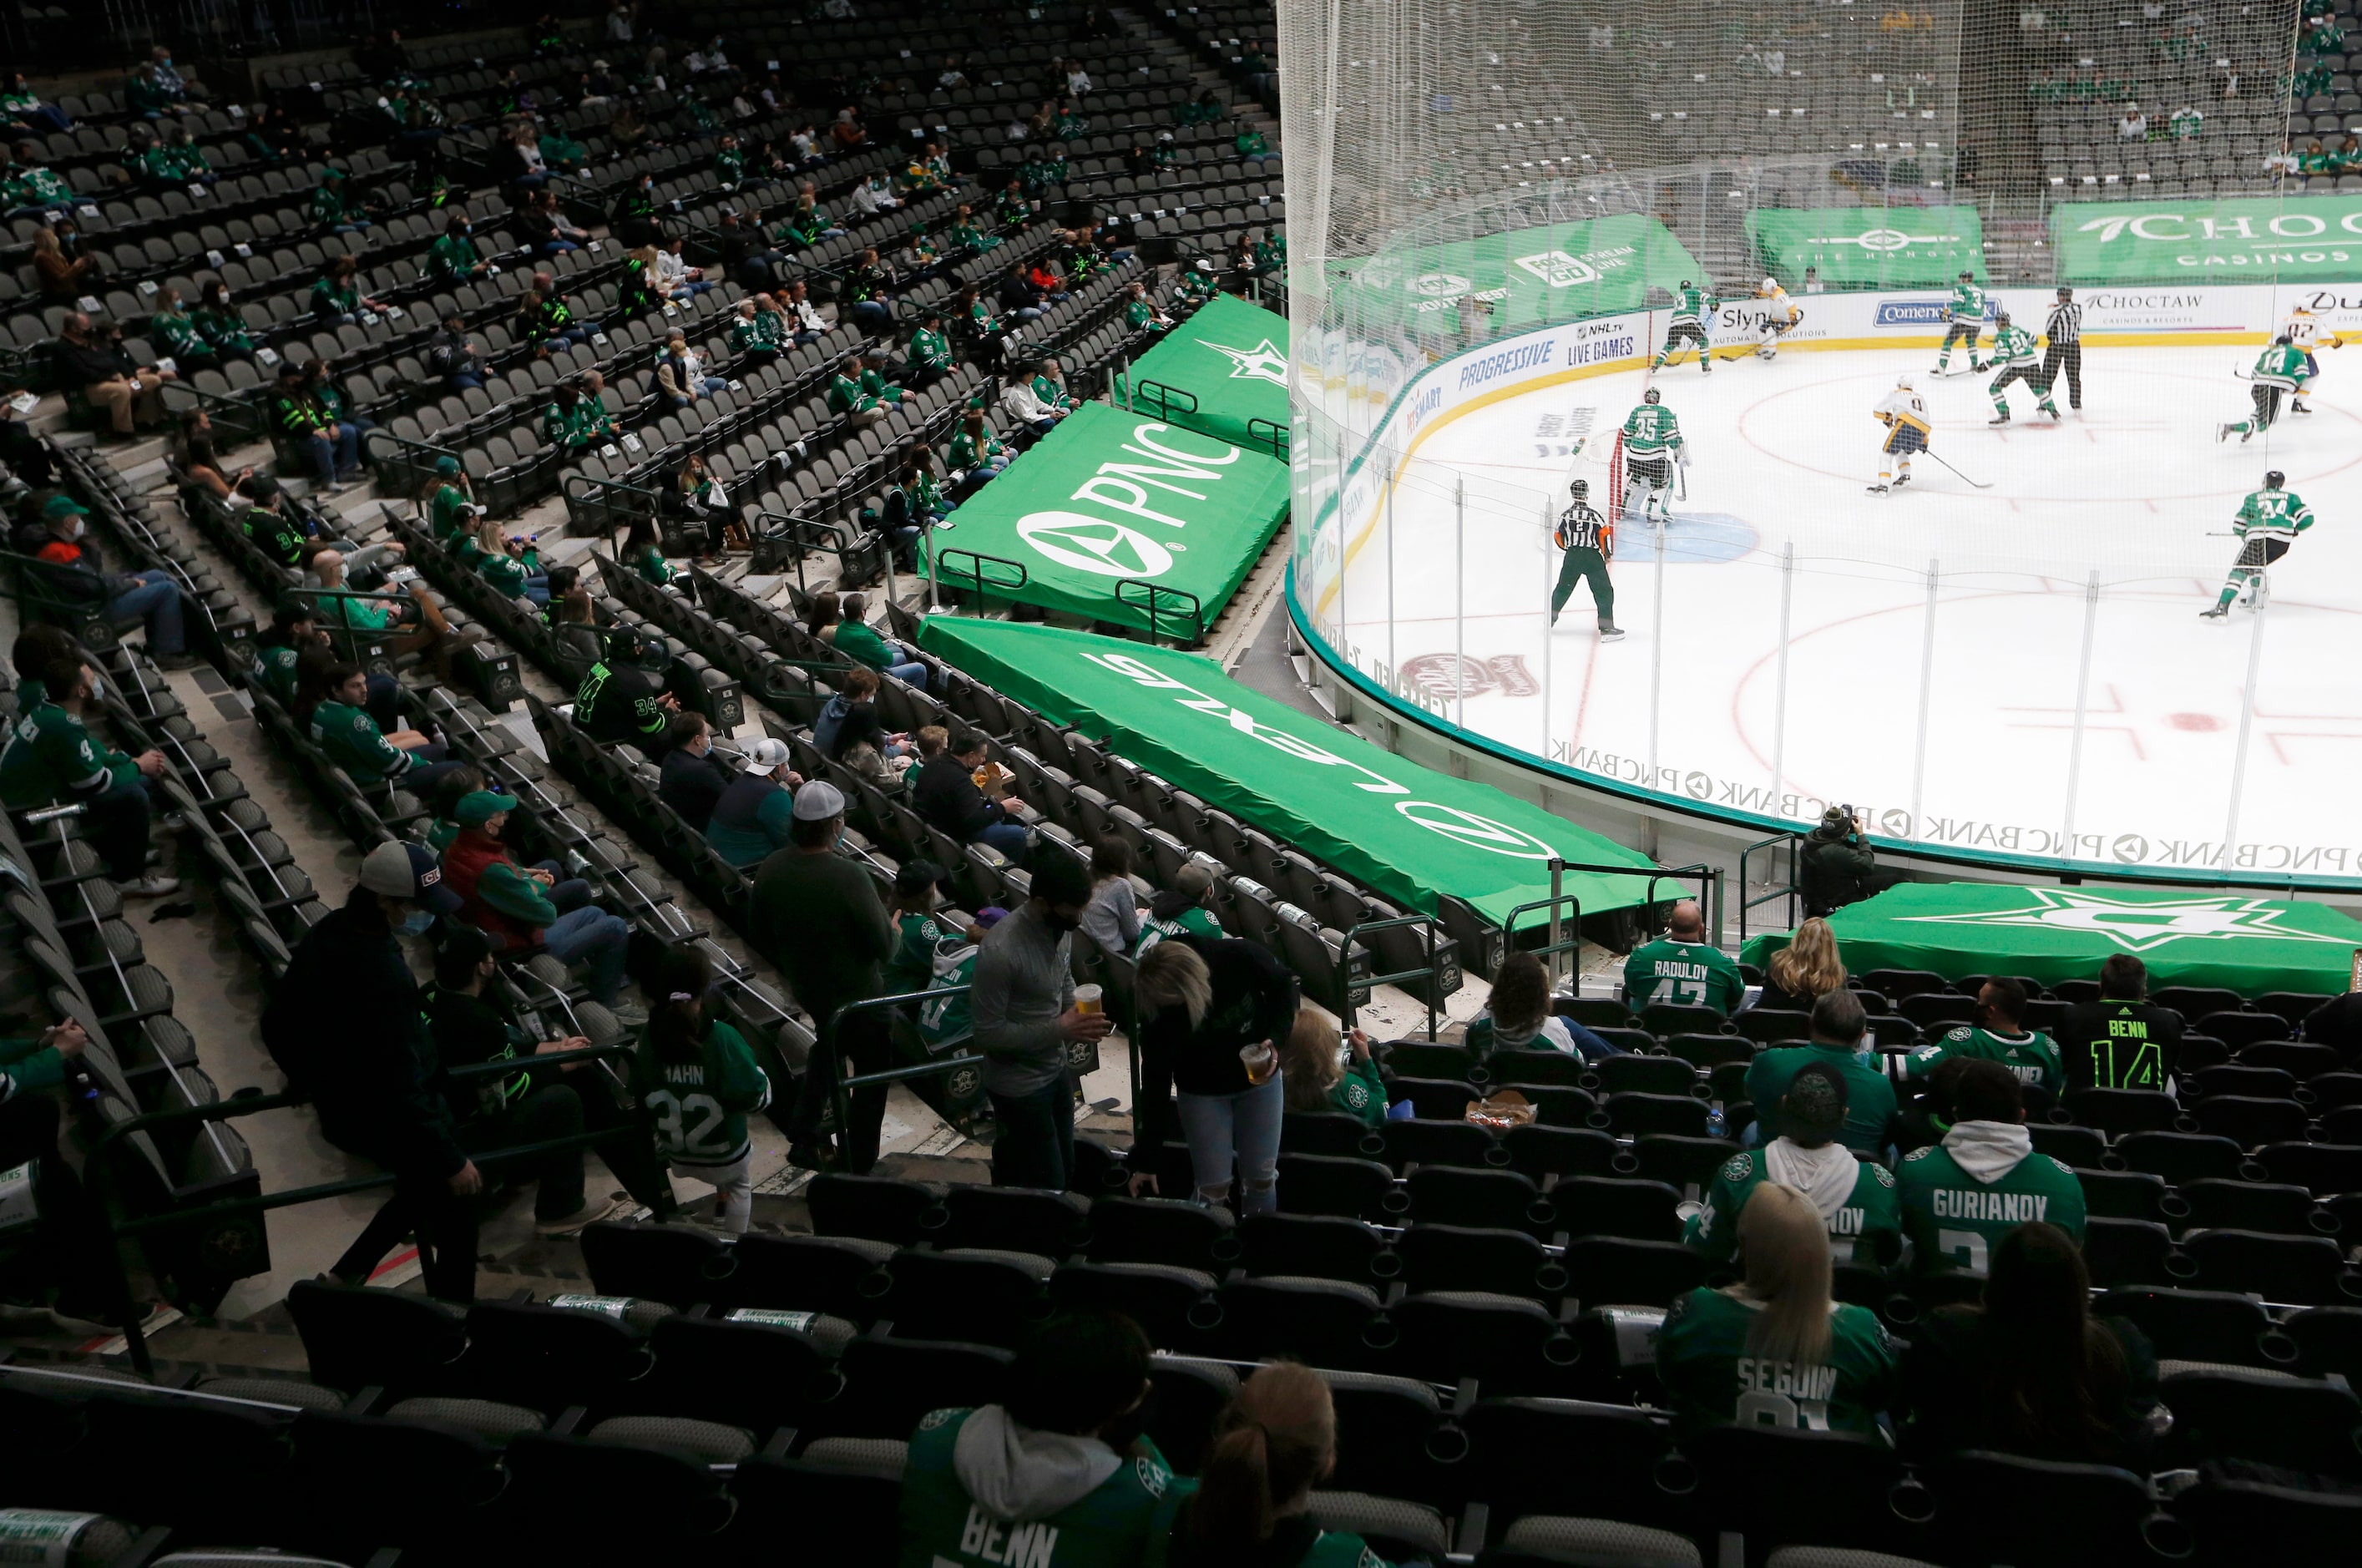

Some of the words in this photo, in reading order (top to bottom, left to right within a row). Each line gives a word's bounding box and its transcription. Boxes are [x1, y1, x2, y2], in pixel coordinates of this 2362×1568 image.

[1579, 247, 1636, 260] STREAM
[1796, 253, 1843, 262] THE
[1865, 249, 1978, 260] HANGAR
[2177, 250, 2349, 266] CASINOS
[1550, 266, 1588, 282] GO
[1593, 259, 1626, 270] LIVE
[2096, 294, 2203, 310] CHOCTAW
[1589, 323, 1623, 336] NHL.TV
[1568, 343, 1590, 367] LIVE
[1594, 336, 1633, 362] GAMES
[1459, 339, 1555, 392] PROGRESSIVE
[2261, 351, 2286, 374] 14
[1635, 417, 1659, 442] 35
[1070, 422, 1241, 529] PNC
[1576, 521, 1583, 531] 2
[634, 696, 656, 716] 34
[1079, 652, 1413, 796] LEXUS
[1654, 960, 1708, 981] RADULOV
[2108, 1019, 2147, 1039] BENN
[2090, 1039, 2162, 1092] 14
[645, 1089, 731, 1154] 32
[1932, 1188, 2048, 1222] GURIANOV
[1737, 1357, 1837, 1400] SEGUIN
